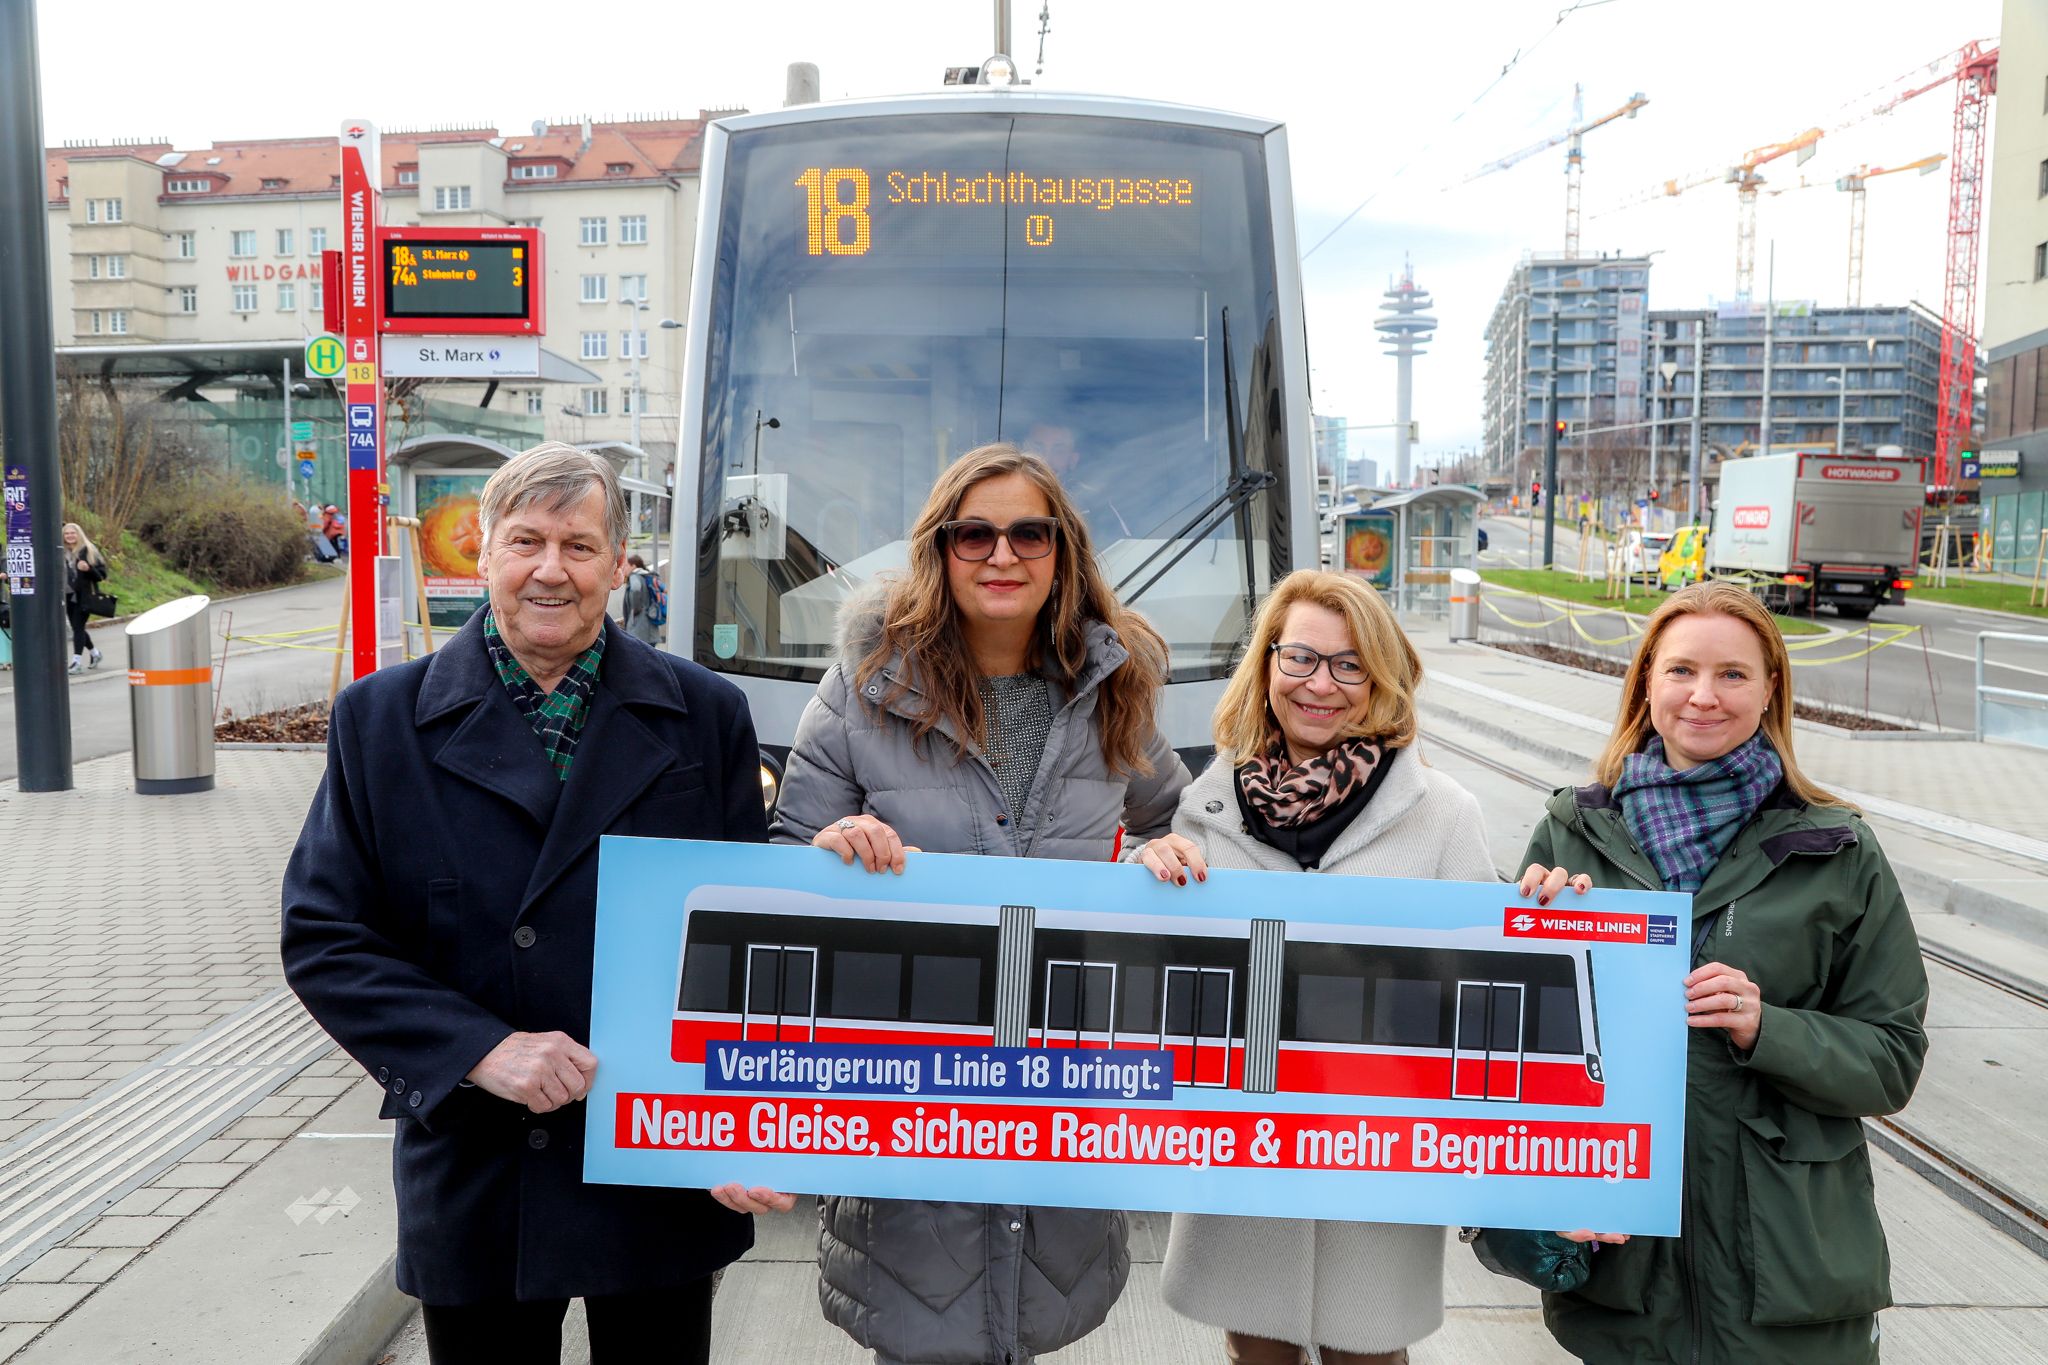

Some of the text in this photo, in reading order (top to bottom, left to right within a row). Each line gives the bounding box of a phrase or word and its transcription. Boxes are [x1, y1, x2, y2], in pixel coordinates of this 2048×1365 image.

[795, 168, 1193, 255] 18 Schlachthausgasse
[350, 190, 366, 308] WIENER LINIEN
[226, 263, 321, 281] WILDGAN
[391, 265, 418, 286] 74A
[512, 267, 523, 287] 3
[315, 344, 336, 369] H
[419, 348, 484, 362] St. Marx
[352, 367, 370, 380] 18
[350, 433, 375, 447] 74A
[1827, 467, 1895, 480] HOTWAGNER
[1965, 463, 1977, 478] P
[1541, 918, 1641, 934] WIENER LINIEN
[1725, 900, 1736, 937] RIKSONS
[717, 1047, 1161, 1098] Verlängerung Linie 18 bringt:
[631, 1098, 1639, 1184] Neue Gleise, sichere Radwege & mehr Begrünung!
